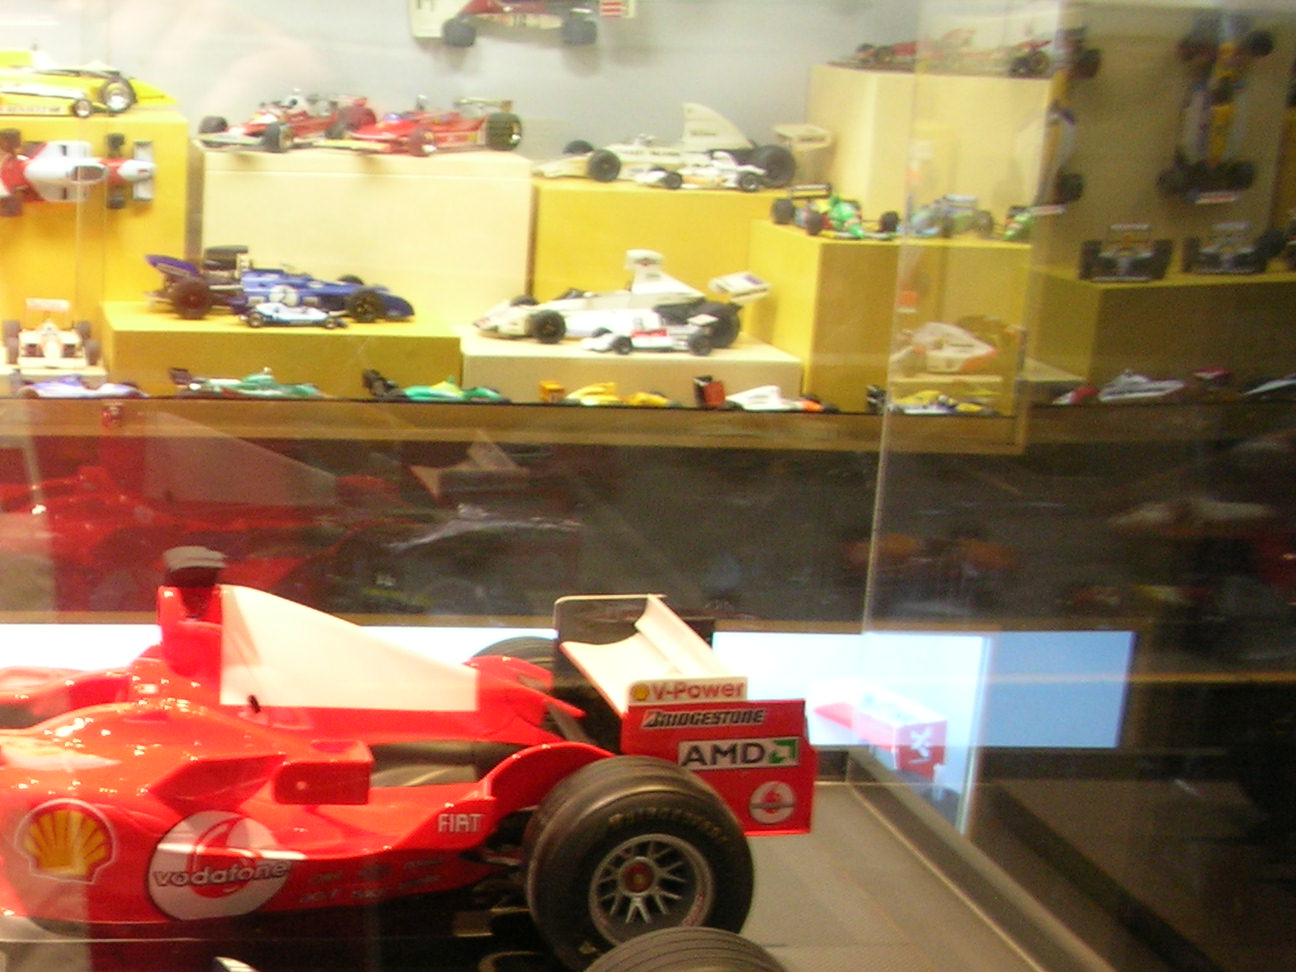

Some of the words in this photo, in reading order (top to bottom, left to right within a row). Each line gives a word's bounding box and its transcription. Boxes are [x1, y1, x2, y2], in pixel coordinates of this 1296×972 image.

[653, 681, 745, 701] V-Power
[642, 709, 766, 729] BRIDGESTONE
[680, 742, 766, 767] AMD
[438, 813, 483, 833] FIAT
[153, 861, 290, 887] vodafone
